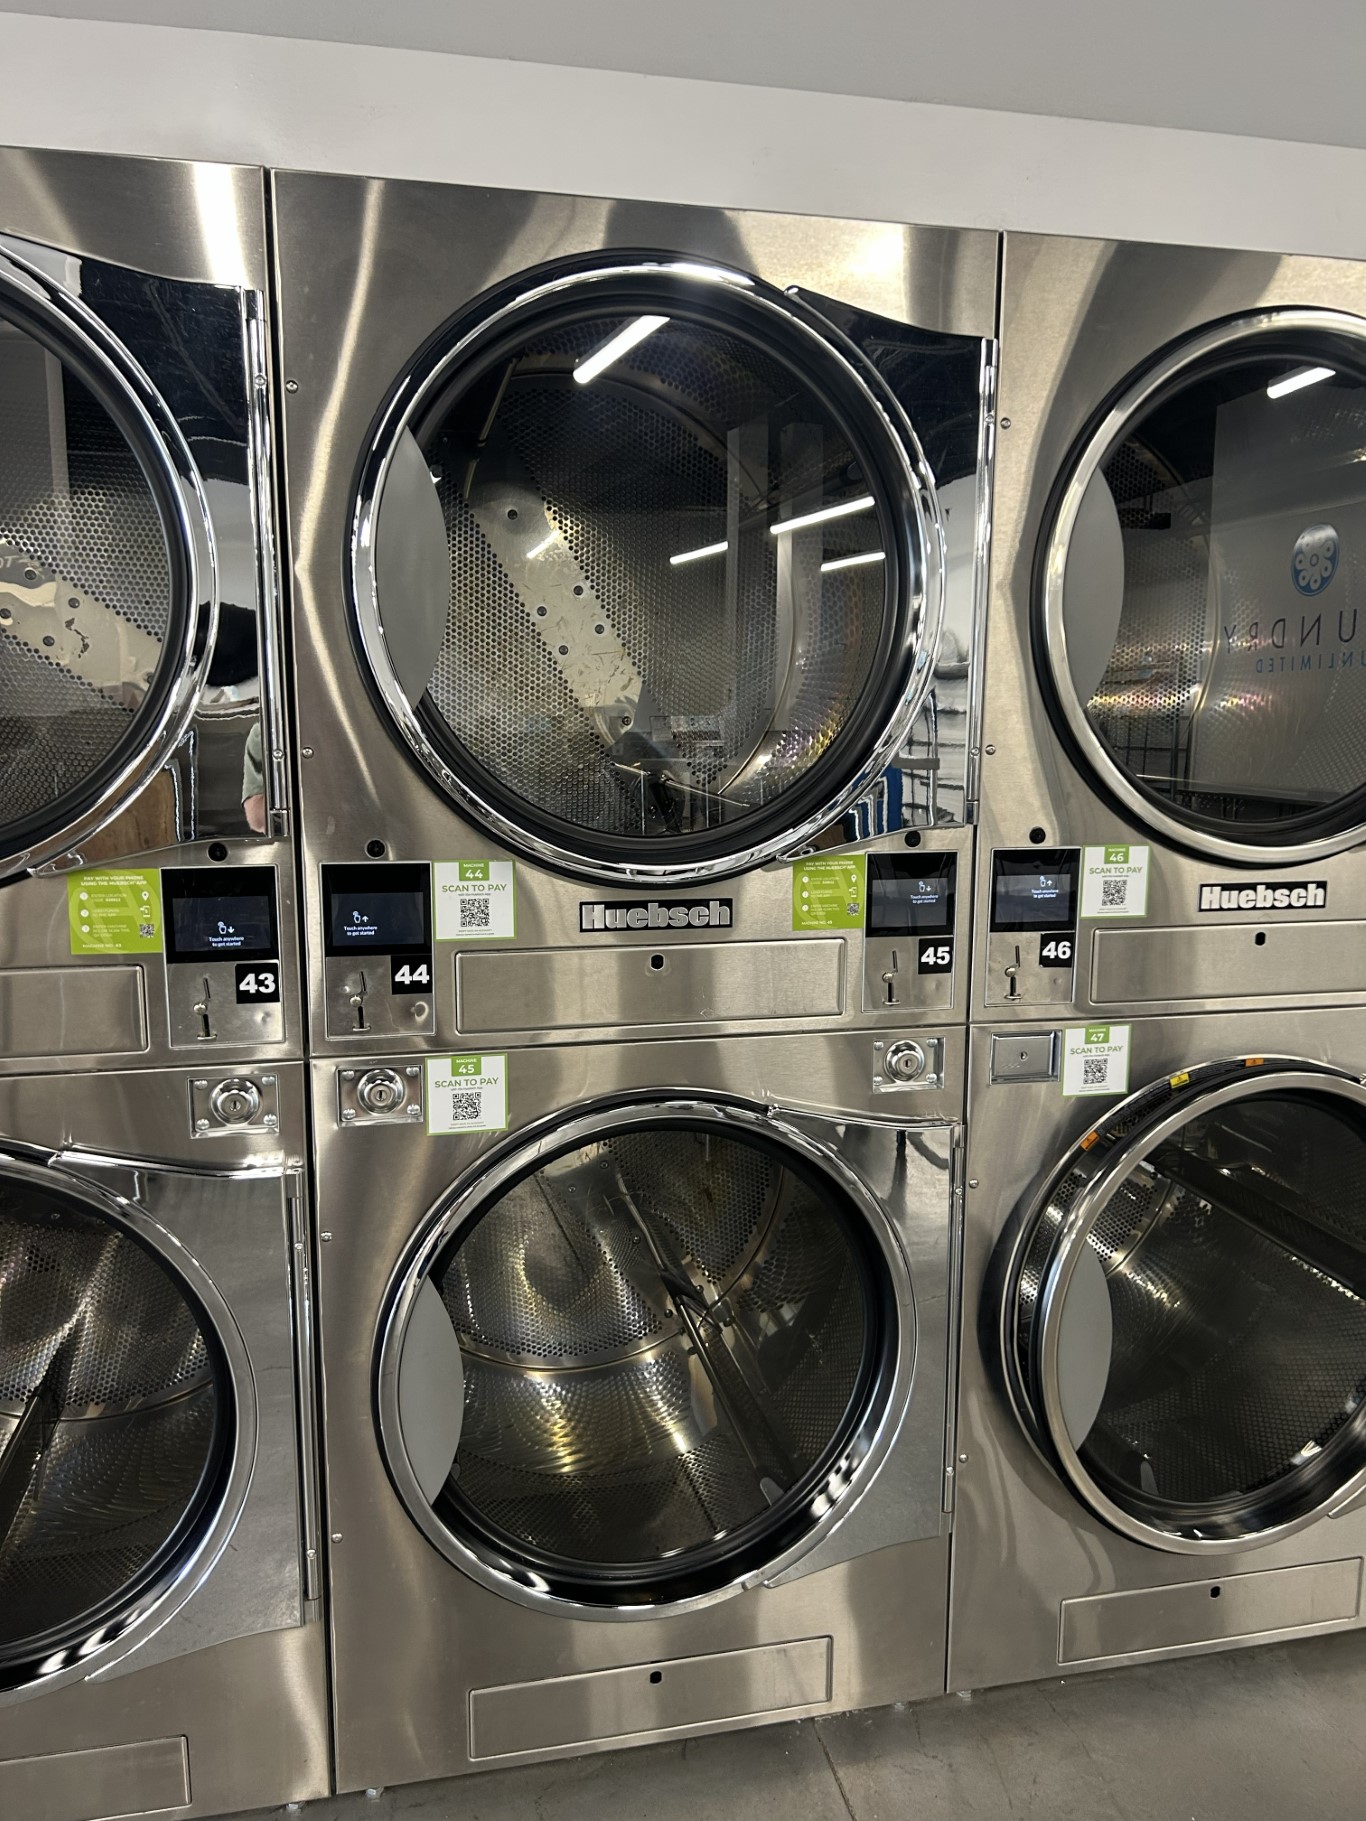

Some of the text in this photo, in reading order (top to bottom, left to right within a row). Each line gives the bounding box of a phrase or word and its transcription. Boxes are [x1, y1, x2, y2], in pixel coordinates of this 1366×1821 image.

[1109, 852, 1124, 862] 46
[465, 869, 483, 879] 44
[471, 884, 485, 892] TO
[488, 883, 507, 891] PAY
[1200, 883, 1325, 910] Huebsch
[582, 900, 730, 929] Huebsch
[920, 946, 950, 965] 45
[1041, 941, 1071, 959] 46
[395, 964, 430, 985] 44
[239, 973, 276, 994] 43
[1090, 1033, 1104, 1042] 47
[1070, 1047, 1092, 1055] SCAN
[1107, 1045, 1124, 1053] PAY
[458, 1064, 475, 1073] 45
[434, 1080, 461, 1088] SCAN
[480, 1077, 499, 1085] PAY
